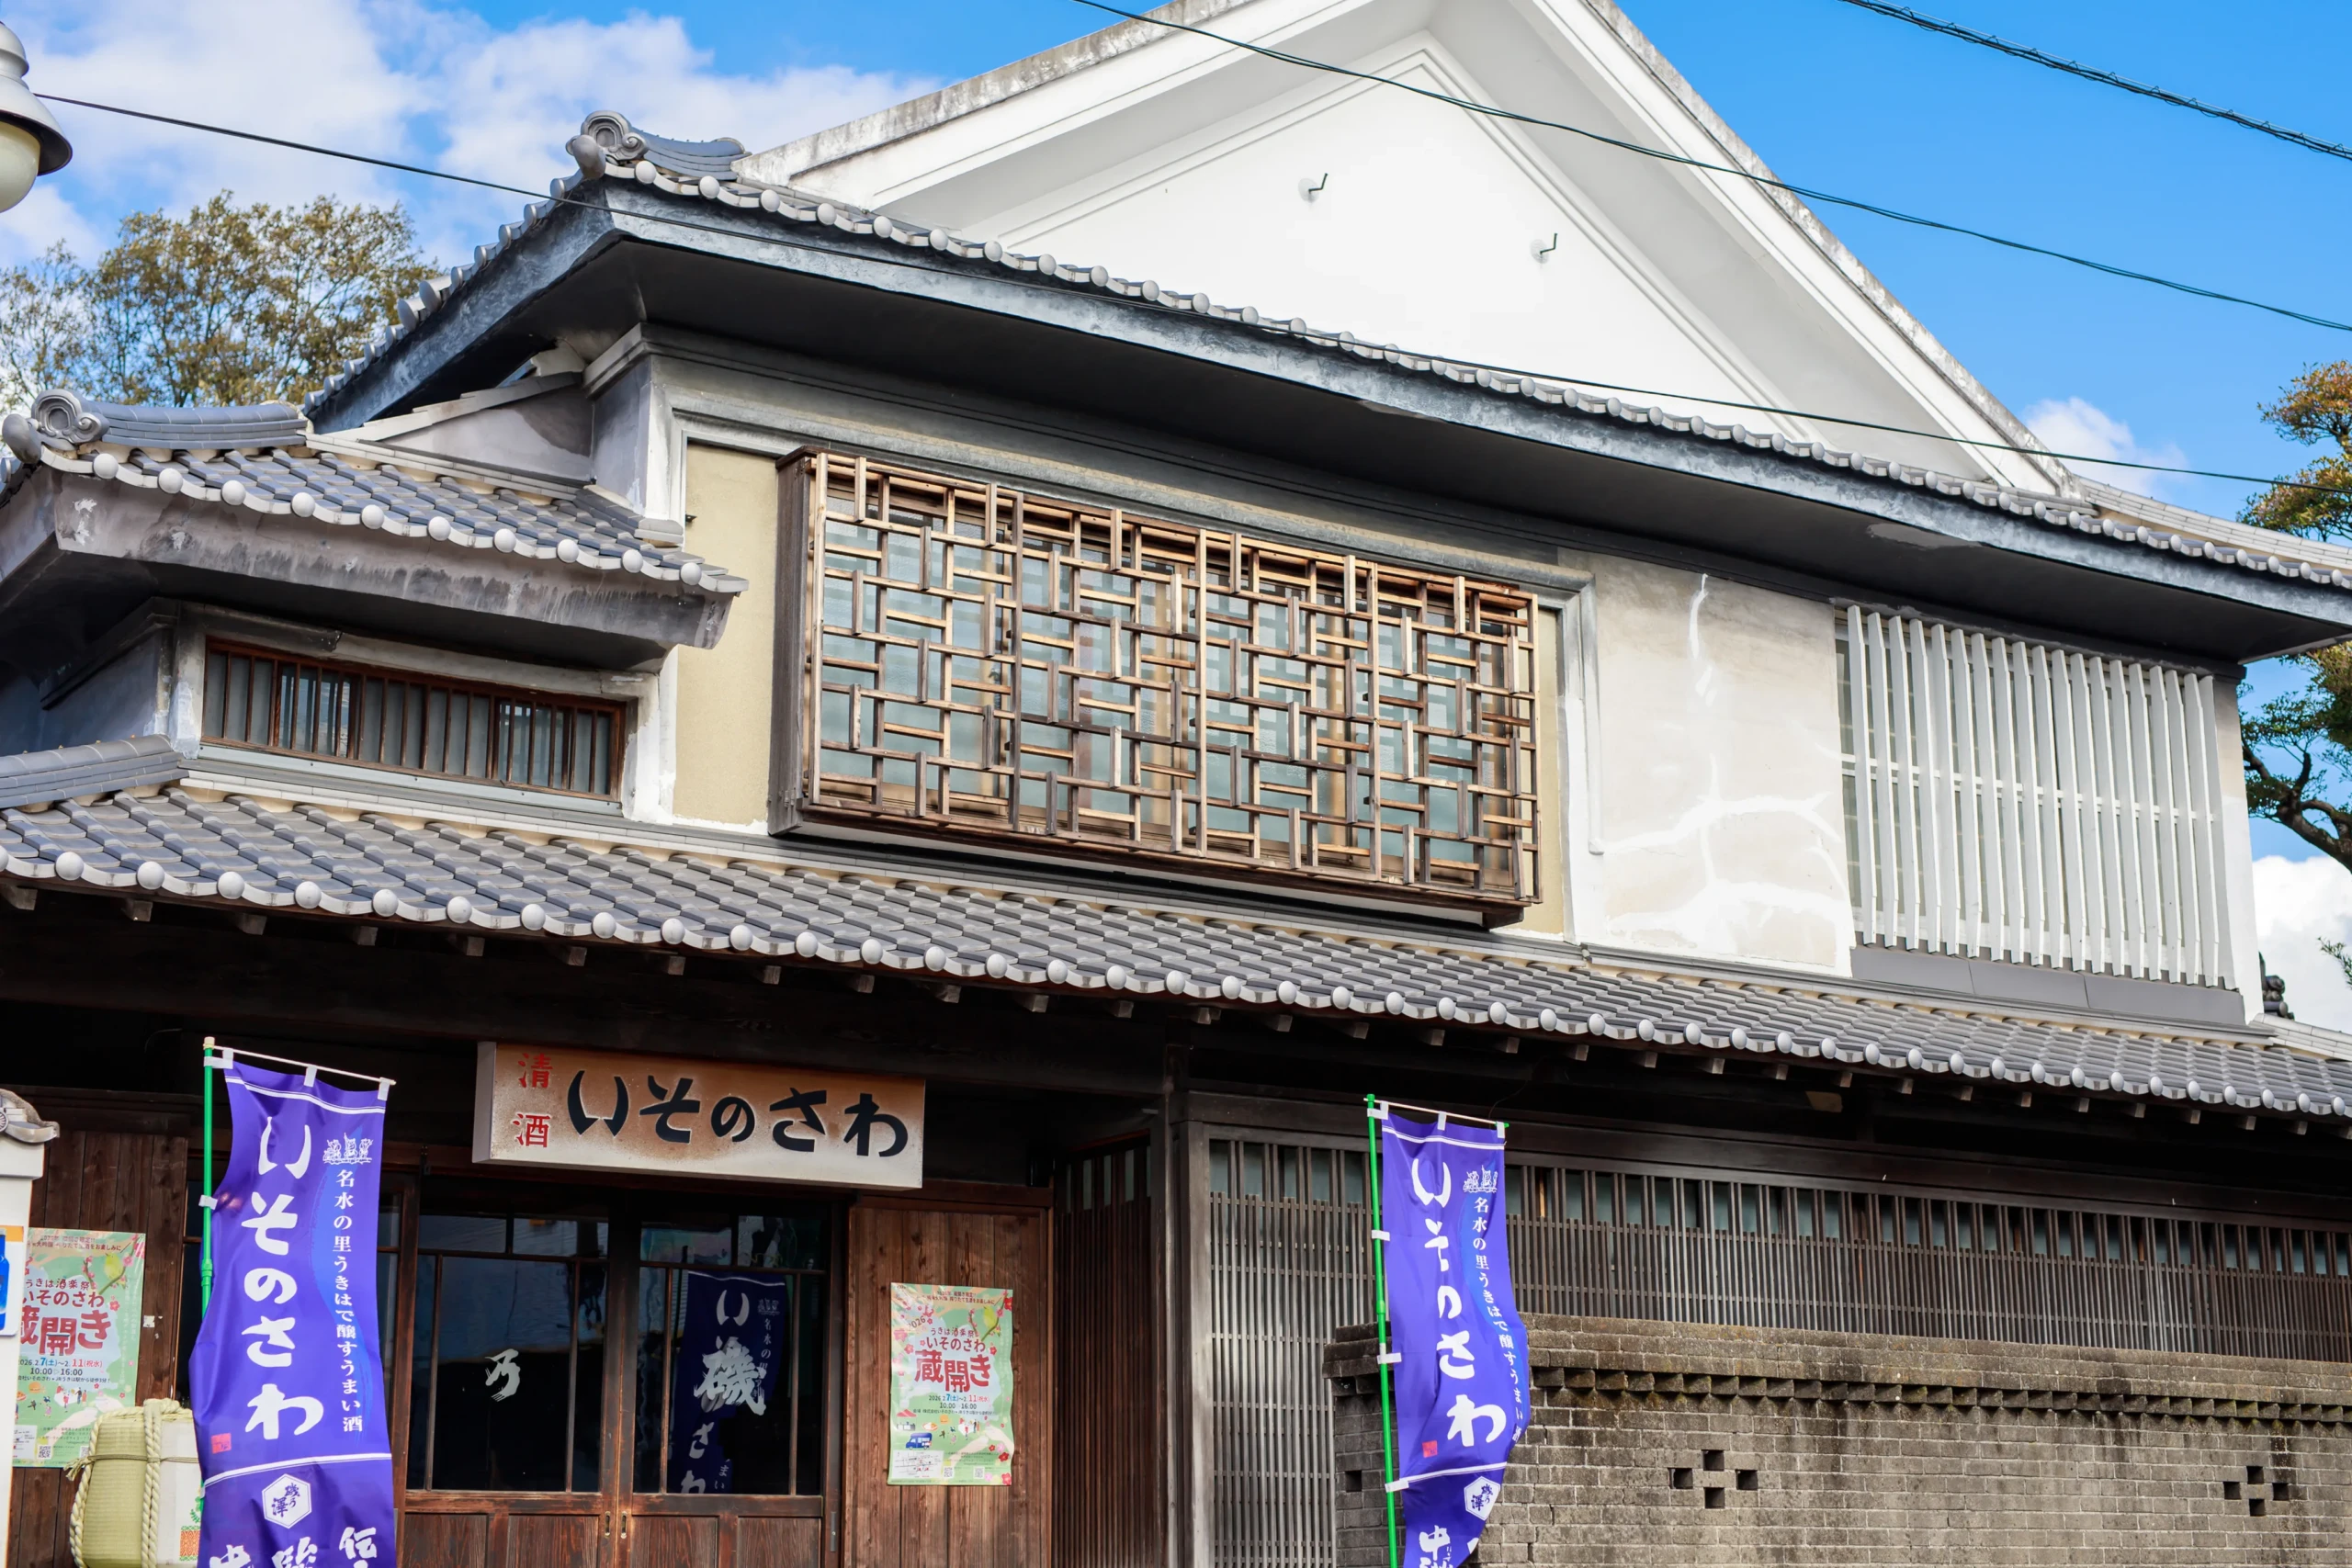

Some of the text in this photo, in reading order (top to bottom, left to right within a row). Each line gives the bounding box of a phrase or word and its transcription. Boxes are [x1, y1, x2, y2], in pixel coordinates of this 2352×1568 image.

[513, 1053, 552, 1148] 清酒
[567, 1069, 909, 1157] いそのさわ
[241, 1116, 323, 1439] いそのさわ
[333, 1169, 363, 1432] 名水の里うきはで醸すうまい酒
[30, 1367, 83, 1376] 10:00 16:00
[914, 1349, 991, 1393] 蔵開き
[926, 1337, 986, 1352] いそのさわ
